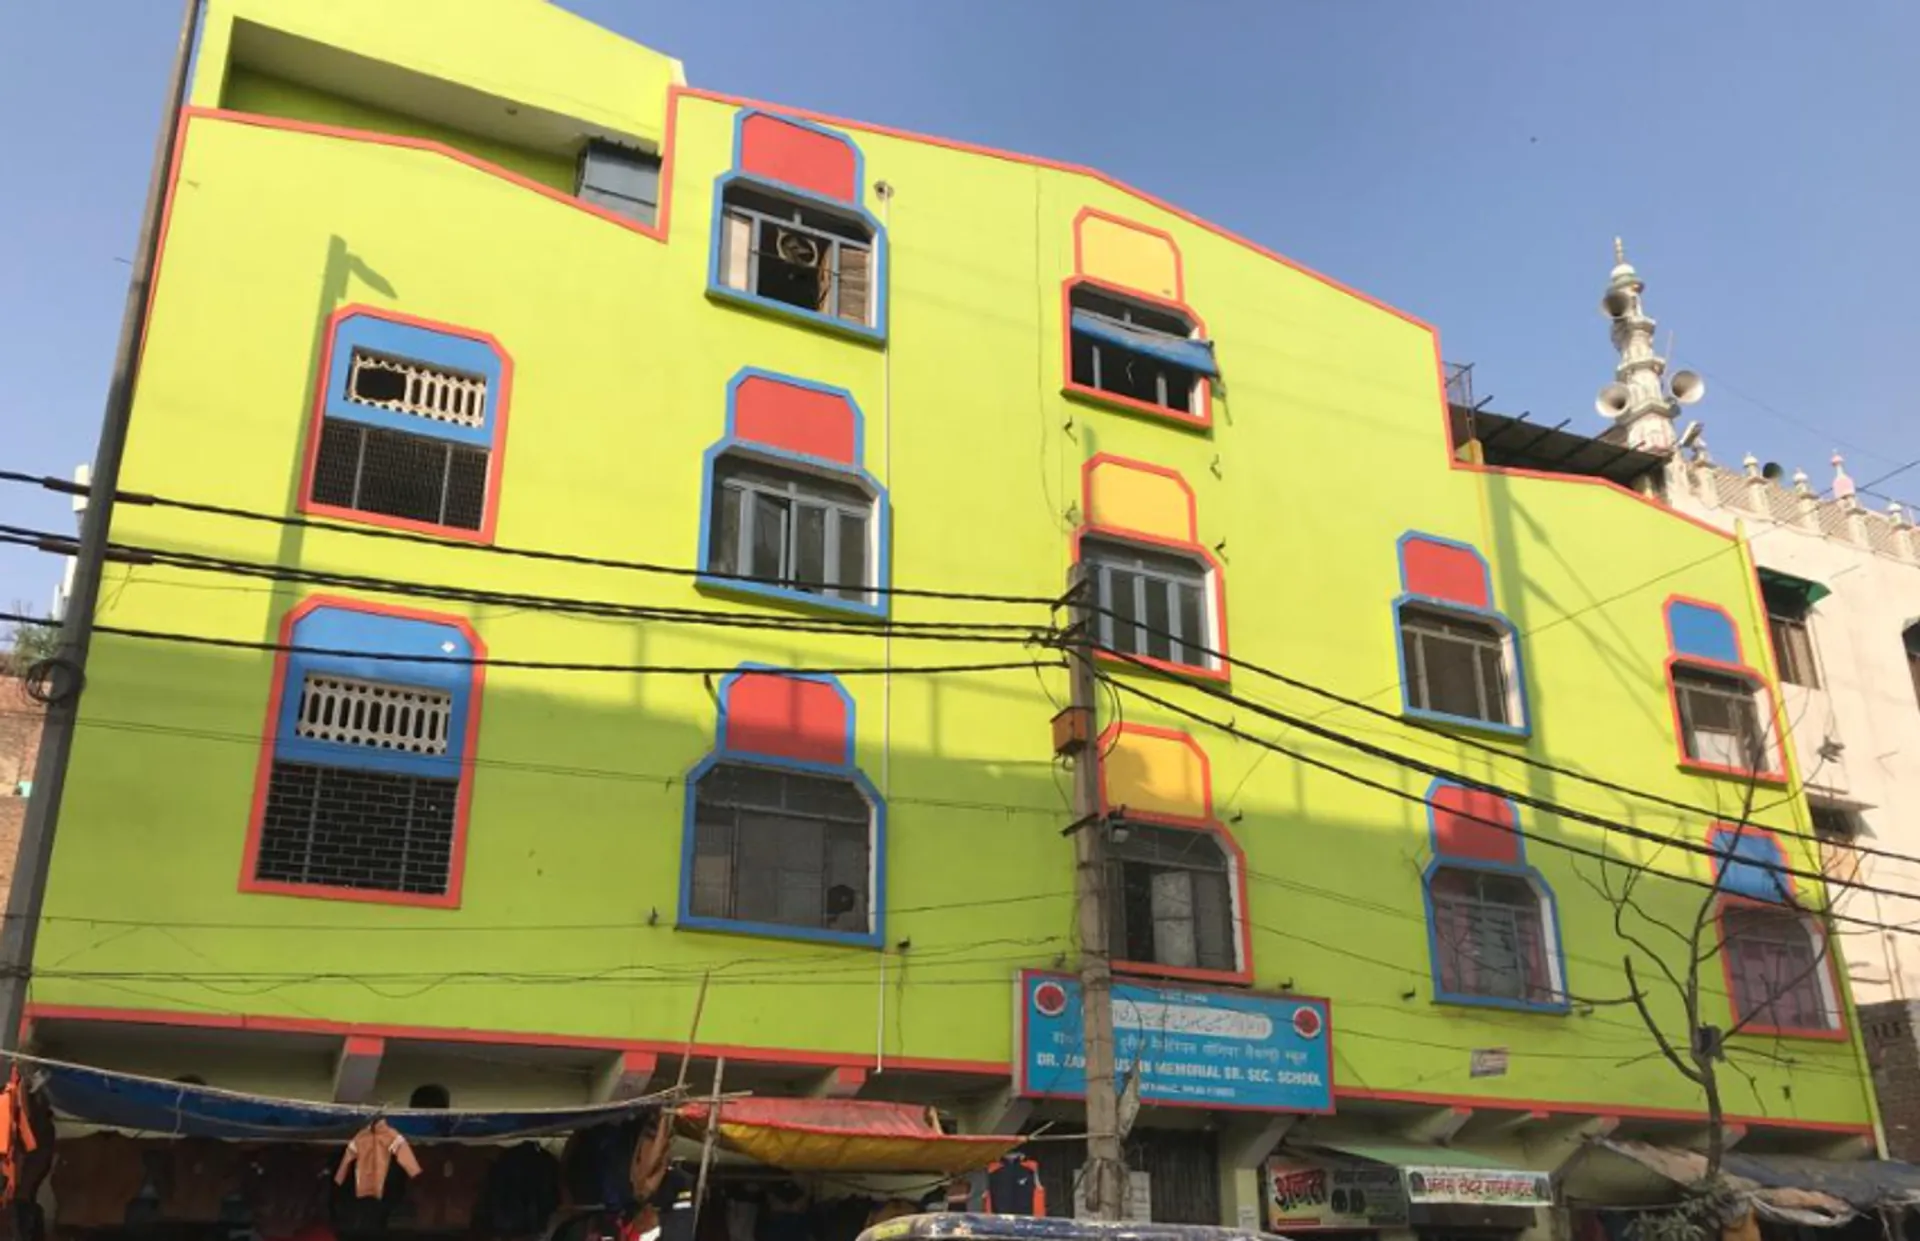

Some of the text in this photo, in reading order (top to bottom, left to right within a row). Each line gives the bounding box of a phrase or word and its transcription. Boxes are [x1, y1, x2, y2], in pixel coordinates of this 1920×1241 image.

[1036, 1051, 1060, 1068] DR.
[1154, 1060, 1222, 1078] MEMORIAL
[1223, 1066, 1245, 1080] SR.
[1247, 1067, 1274, 1083] SEC.
[1277, 1070, 1322, 1087] SCHOOL
